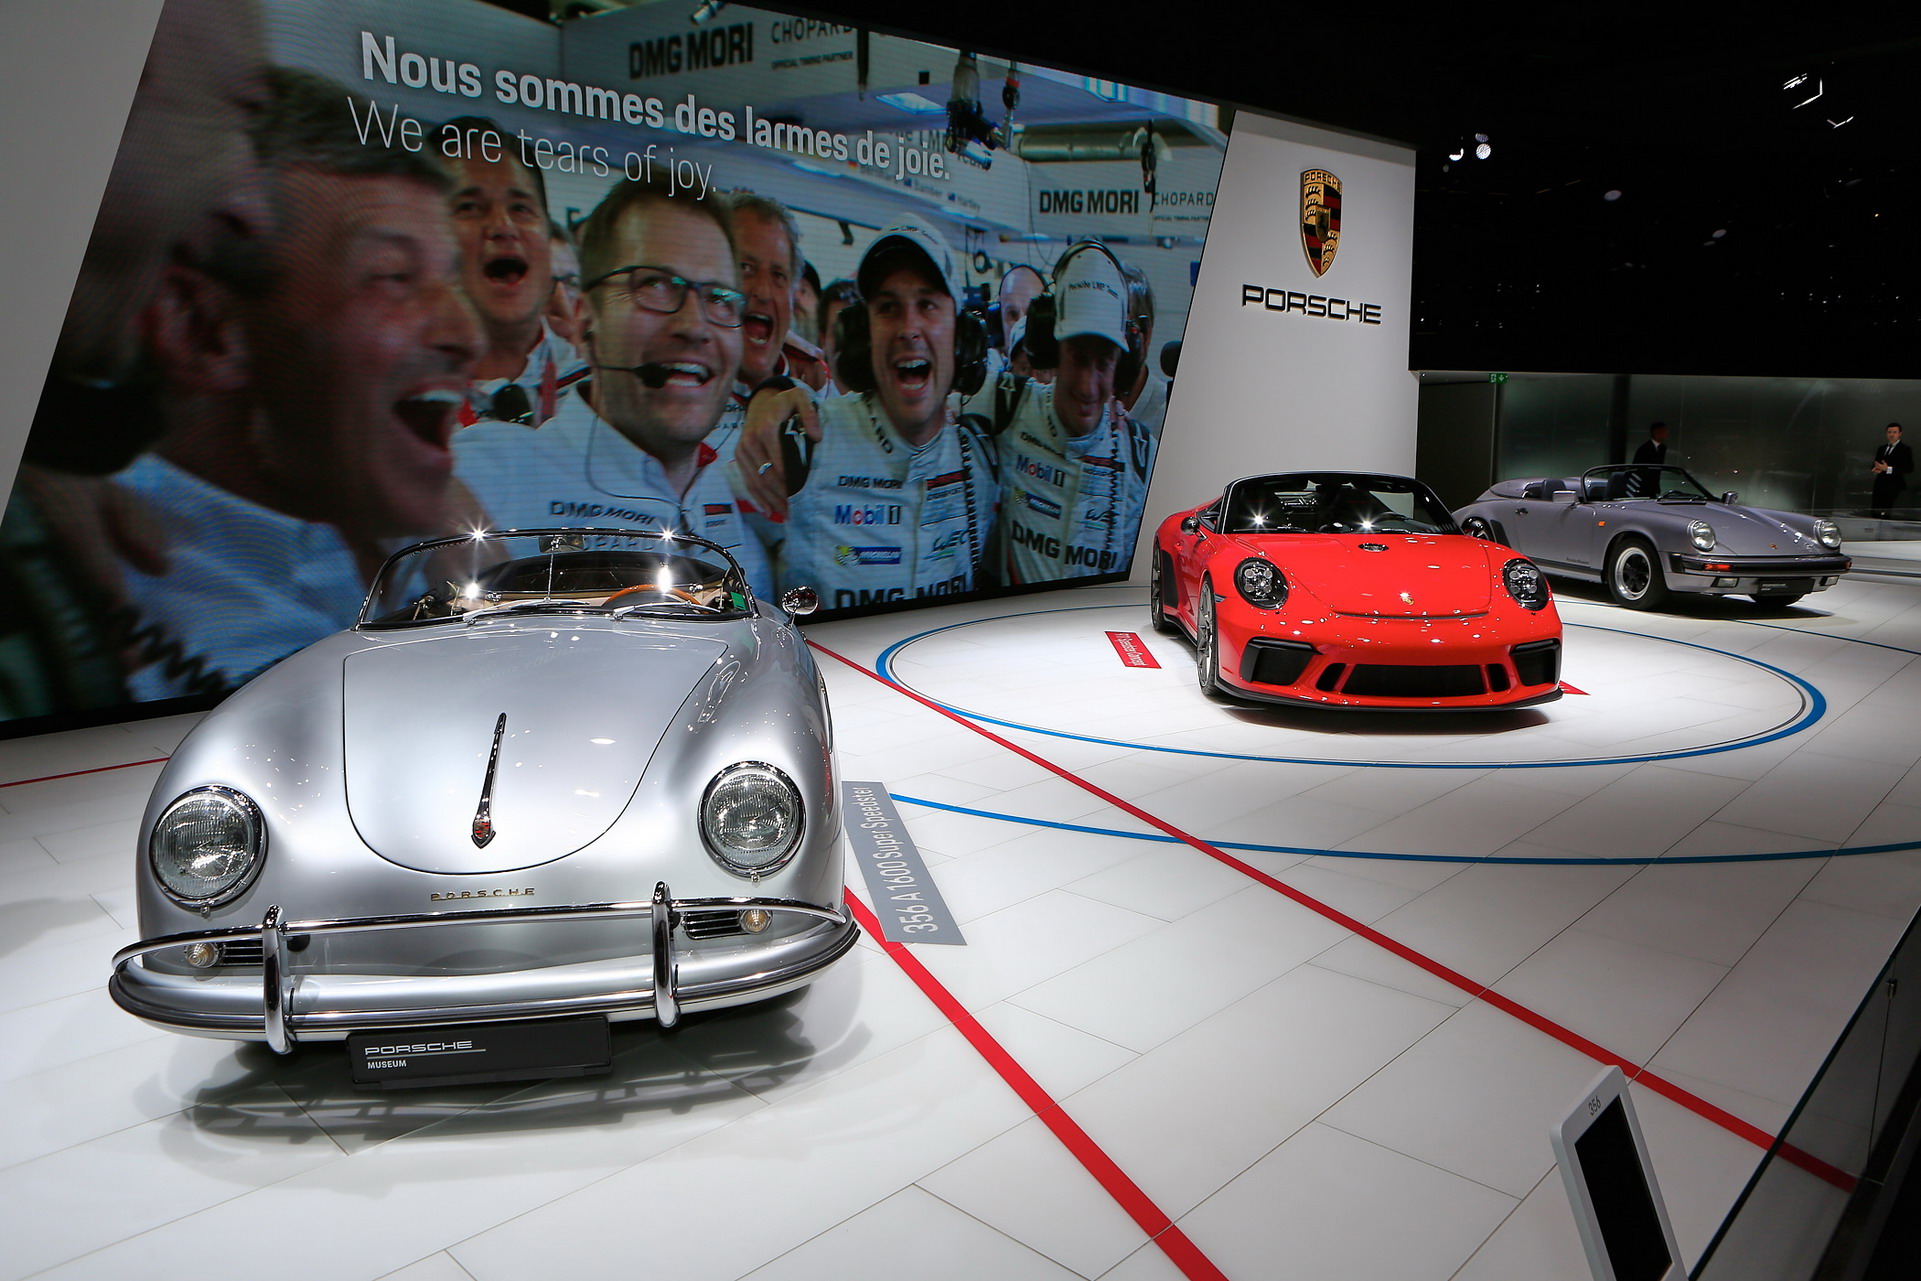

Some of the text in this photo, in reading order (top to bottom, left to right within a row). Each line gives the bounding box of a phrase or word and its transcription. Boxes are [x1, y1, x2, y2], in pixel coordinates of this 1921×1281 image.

[629, 21, 753, 79] DMG MORI
[361, 31, 482, 98] Nous
[495, 70, 664, 129] sommes
[675, 94, 736, 141] des
[745, 105, 848, 161] larmes
[856, 130, 890, 169] de
[896, 136, 950, 180] joie.
[347, 96, 717, 201] We are tears of joy.
[1304, 171, 1342, 192] PORSCHE
[1039, 189, 1214, 214] DMG MORI CHOPARD
[1242, 284, 1382, 325] PORSCHE
[1016, 454, 1053, 482] Mobil
[602, 507, 656, 526] MORI
[834, 504, 902, 525] Mobil 1
[1012, 520, 1060, 559] DMG
[834, 587, 904, 608] DMG
[851, 787, 938, 934] 356 A 1600 Super Speedster
[430, 887, 535, 901] PORSCHE
[364, 1040, 473, 1056] PORSCHE
[367, 1060, 407, 1069] MUSEUM
[1588, 1095, 1602, 1116] 356
